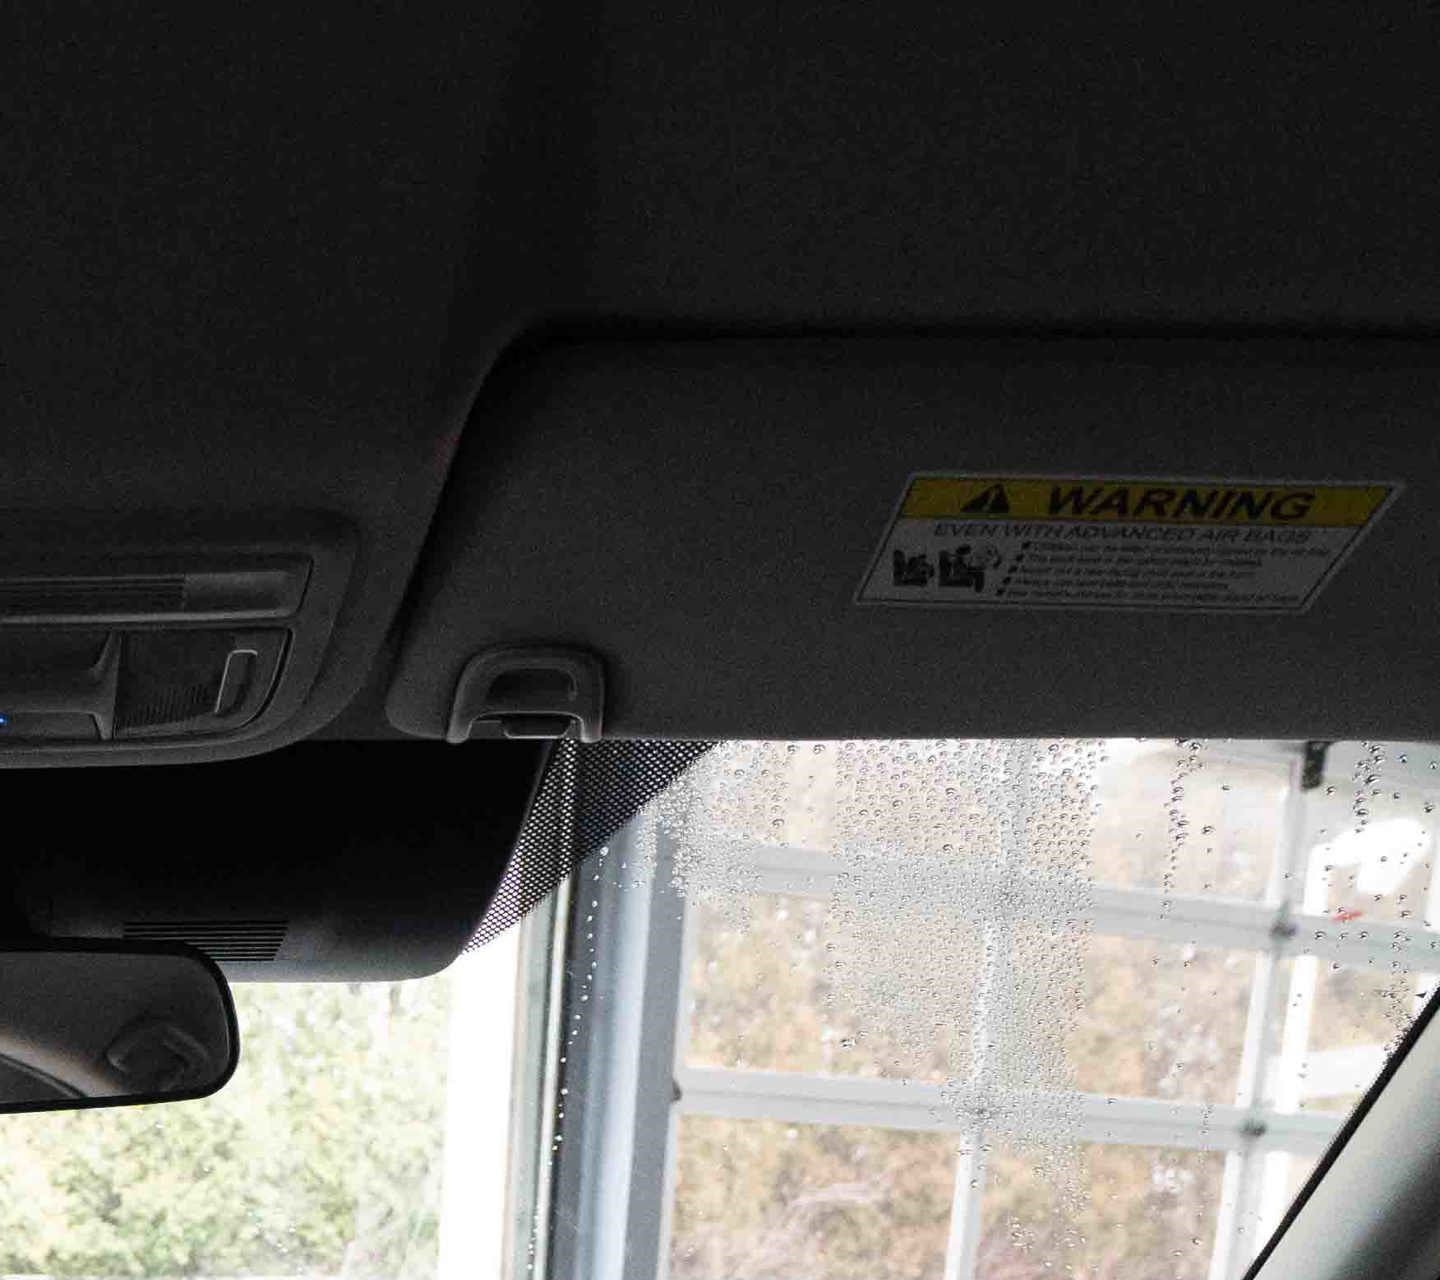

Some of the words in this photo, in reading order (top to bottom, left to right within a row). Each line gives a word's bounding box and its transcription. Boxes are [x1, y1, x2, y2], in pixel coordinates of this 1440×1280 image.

[1049, 486, 1315, 521] WARNING
[934, 522, 996, 537] EVEN
[1004, 524, 1065, 538] WITH
[1067, 525, 1195, 542] ADVANCED
[1201, 528, 1240, 543] AIR
